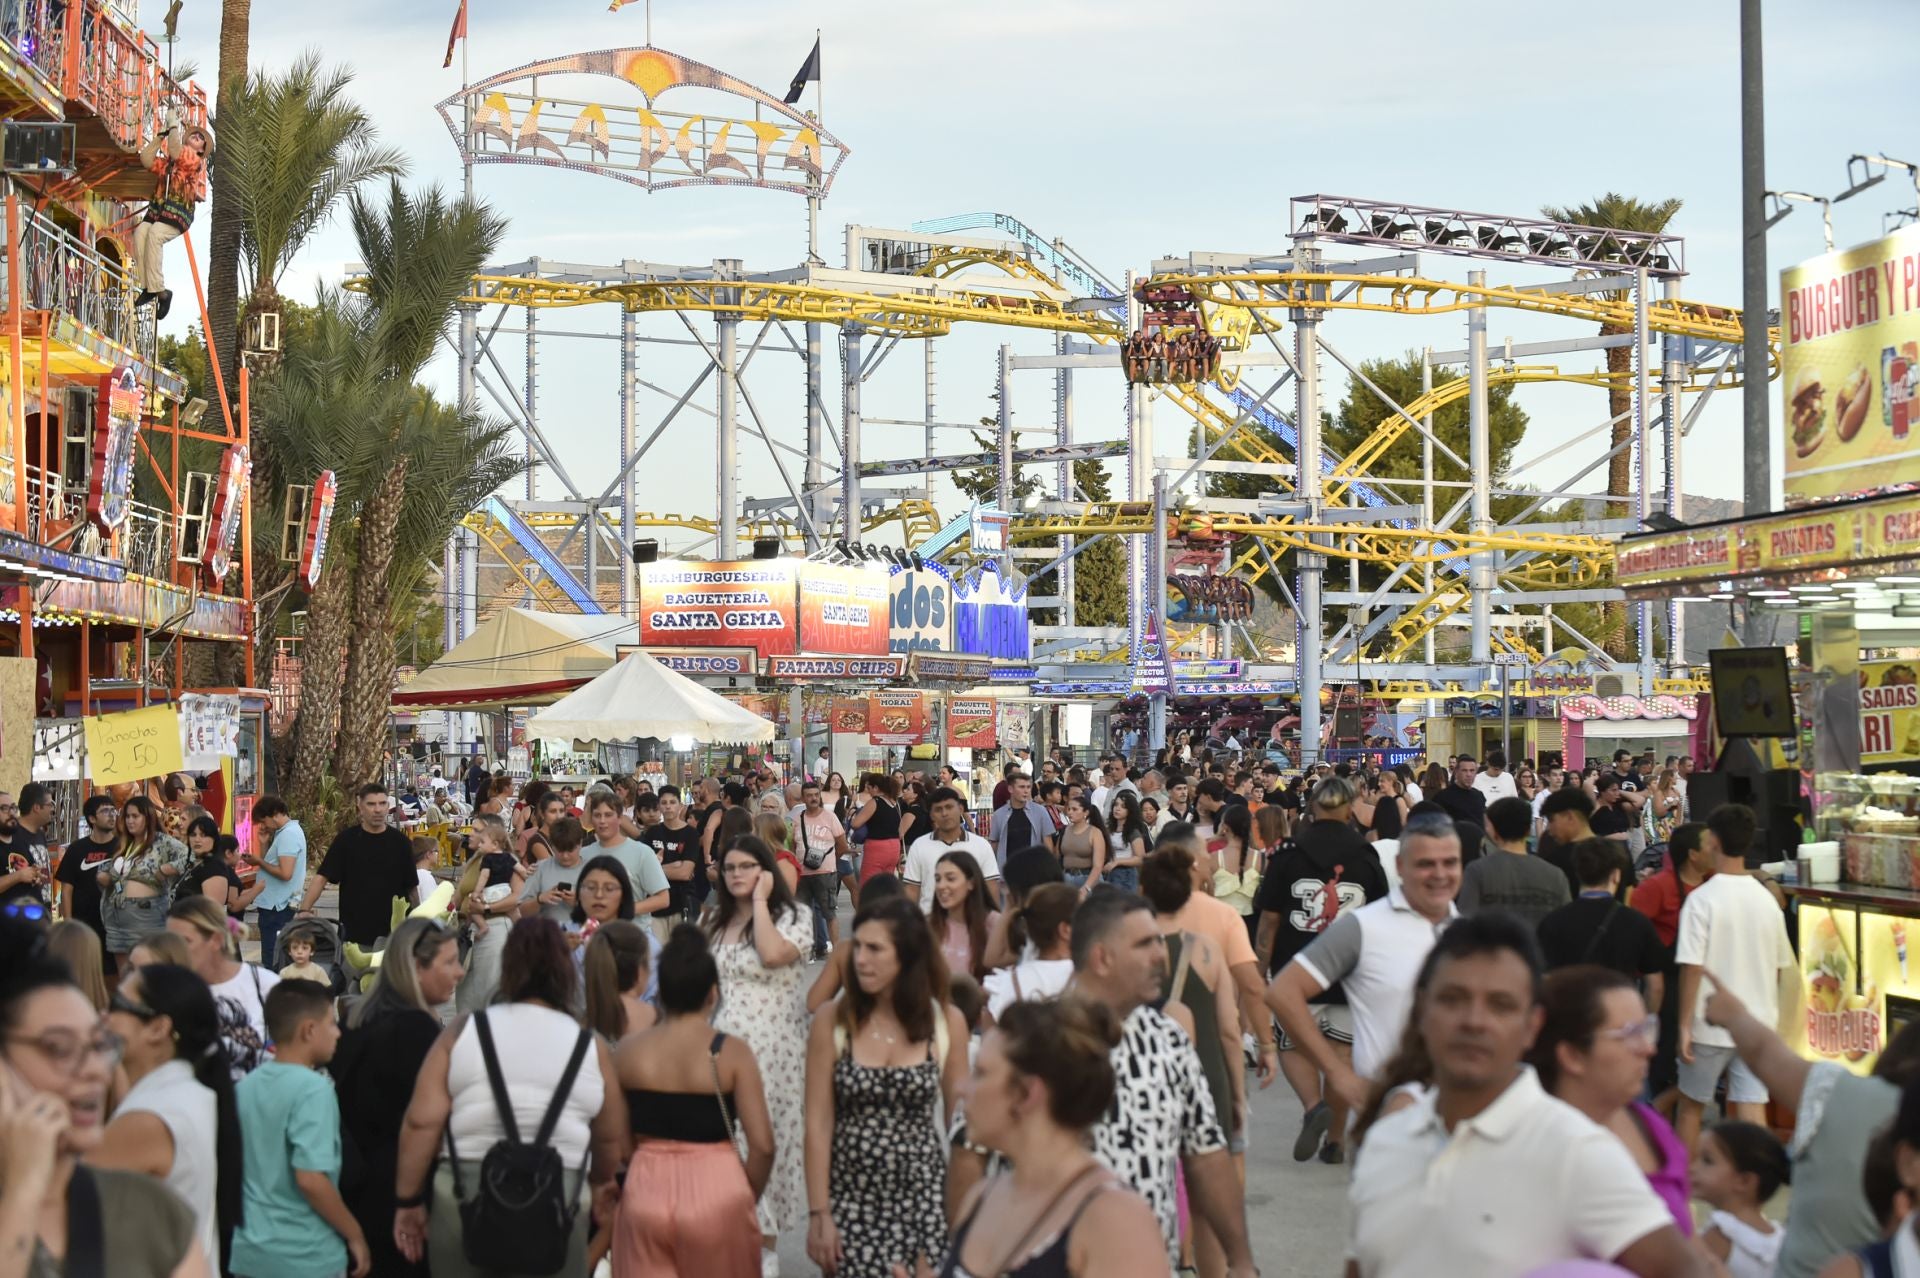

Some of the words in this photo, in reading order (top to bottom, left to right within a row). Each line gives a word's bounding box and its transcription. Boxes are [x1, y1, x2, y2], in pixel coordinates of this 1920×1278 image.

[469, 92, 609, 163] ALA
[637, 106, 822, 184] DELTA
[1789, 266, 1879, 344] BURGUER
[1884, 260, 1895, 316] Y
[665, 590, 769, 604] BAGUETTERÍA
[890, 572, 945, 629] dos
[652, 613, 719, 627] SANTA
[725, 612, 782, 626] GEMA
[823, 604, 847, 621] SANTA
[652, 657, 739, 671] RRITOS
[776, 661, 844, 674] PATATAS
[849, 662, 896, 674] CHIPS
[1862, 686, 1917, 709] SADAS
